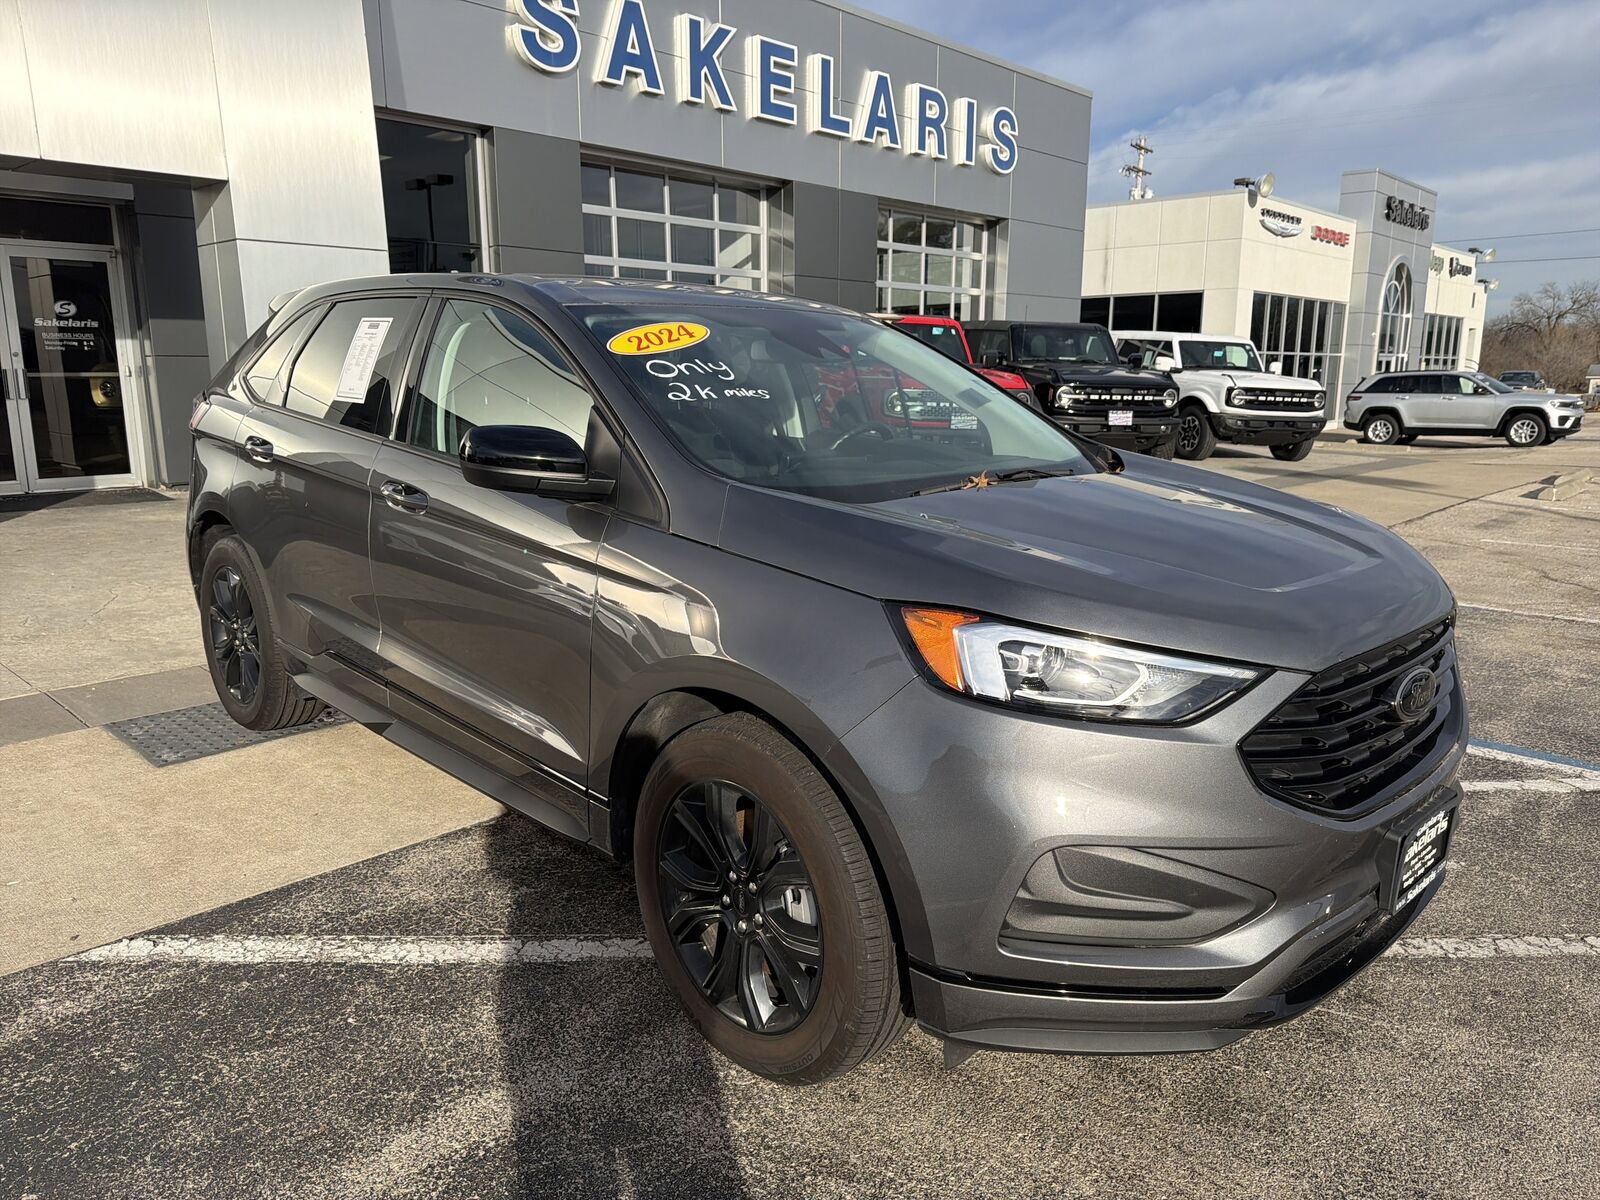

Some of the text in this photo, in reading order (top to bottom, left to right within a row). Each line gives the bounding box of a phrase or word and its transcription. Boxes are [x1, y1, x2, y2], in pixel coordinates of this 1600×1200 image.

[506, 0, 1018, 174] SAKELARIS
[1385, 196, 1430, 231] Sakelaris
[1312, 226, 1350, 247] DODGE
[34, 317, 99, 327] Sakelaris
[628, 324, 696, 351] 2024
[646, 359, 735, 380] Only
[724, 388, 770, 399] miles
[1411, 679, 1432, 710] Ford
